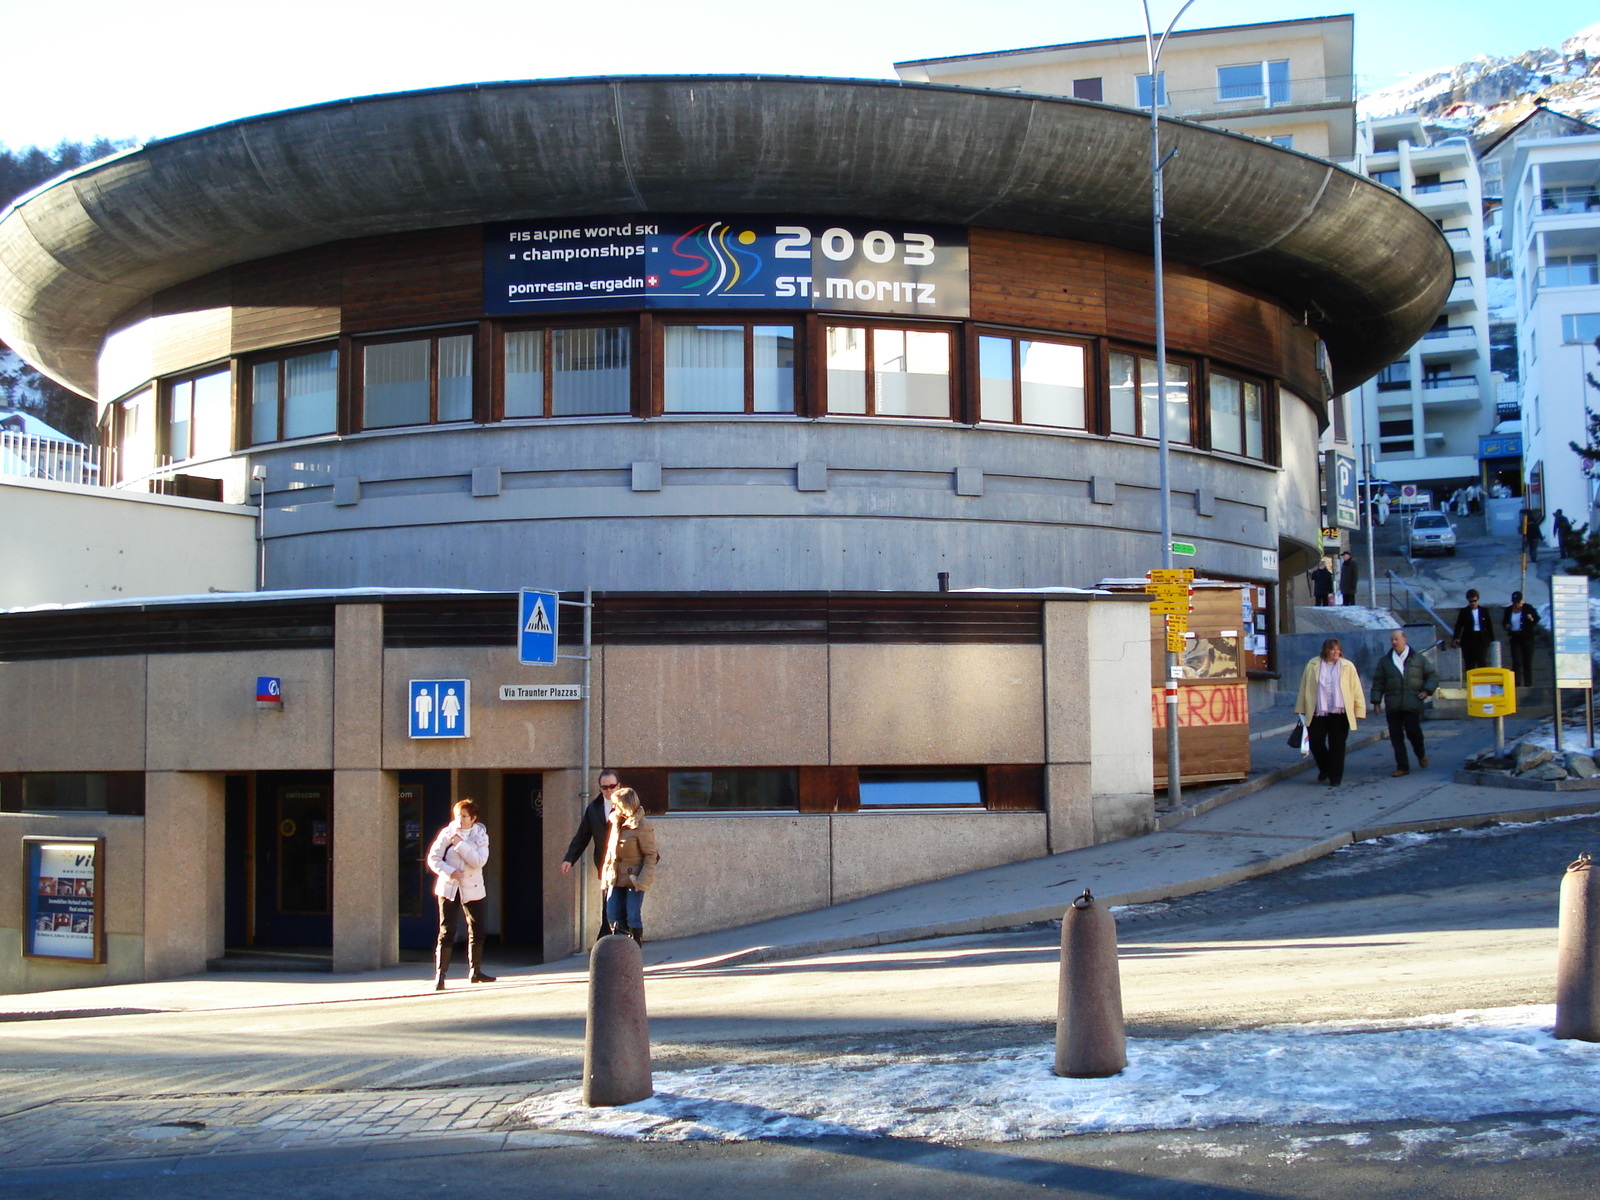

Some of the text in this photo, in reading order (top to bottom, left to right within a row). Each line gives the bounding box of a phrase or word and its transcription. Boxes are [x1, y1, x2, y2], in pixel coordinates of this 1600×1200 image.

[509, 223, 659, 243] FIS alpine world SKI
[522, 243, 645, 262] championships
[774, 225, 935, 266] 2003
[504, 687, 578, 697] Via Traunter Plazzas
[285, 790, 321, 799] swisscom
